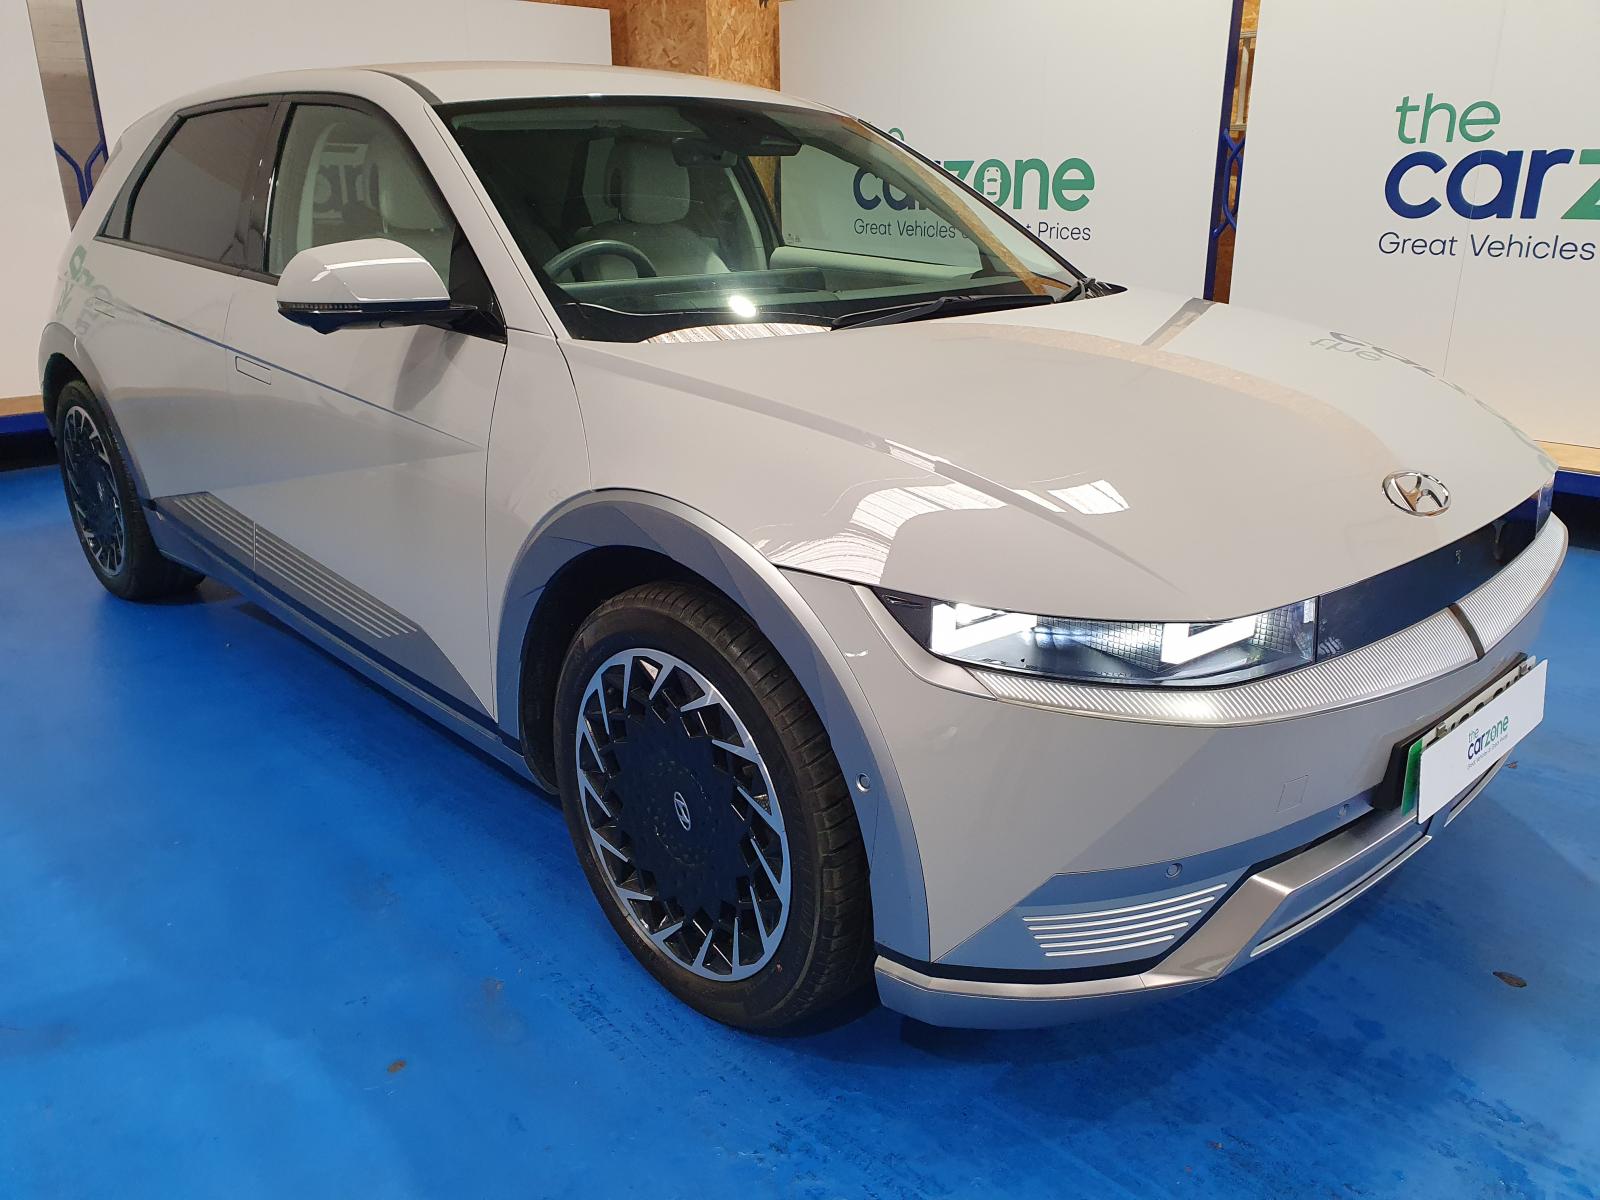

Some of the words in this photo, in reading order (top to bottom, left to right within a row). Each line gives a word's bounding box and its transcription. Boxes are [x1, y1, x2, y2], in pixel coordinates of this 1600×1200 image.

[1395, 93, 1501, 144] the
[853, 218, 893, 236] Great
[897, 220, 957, 239] Vehicles
[1037, 221, 1092, 241] Prices
[1378, 231, 1458, 256] Great
[1470, 233, 1597, 261] Vehicles
[1467, 715, 1509, 760] carzone
